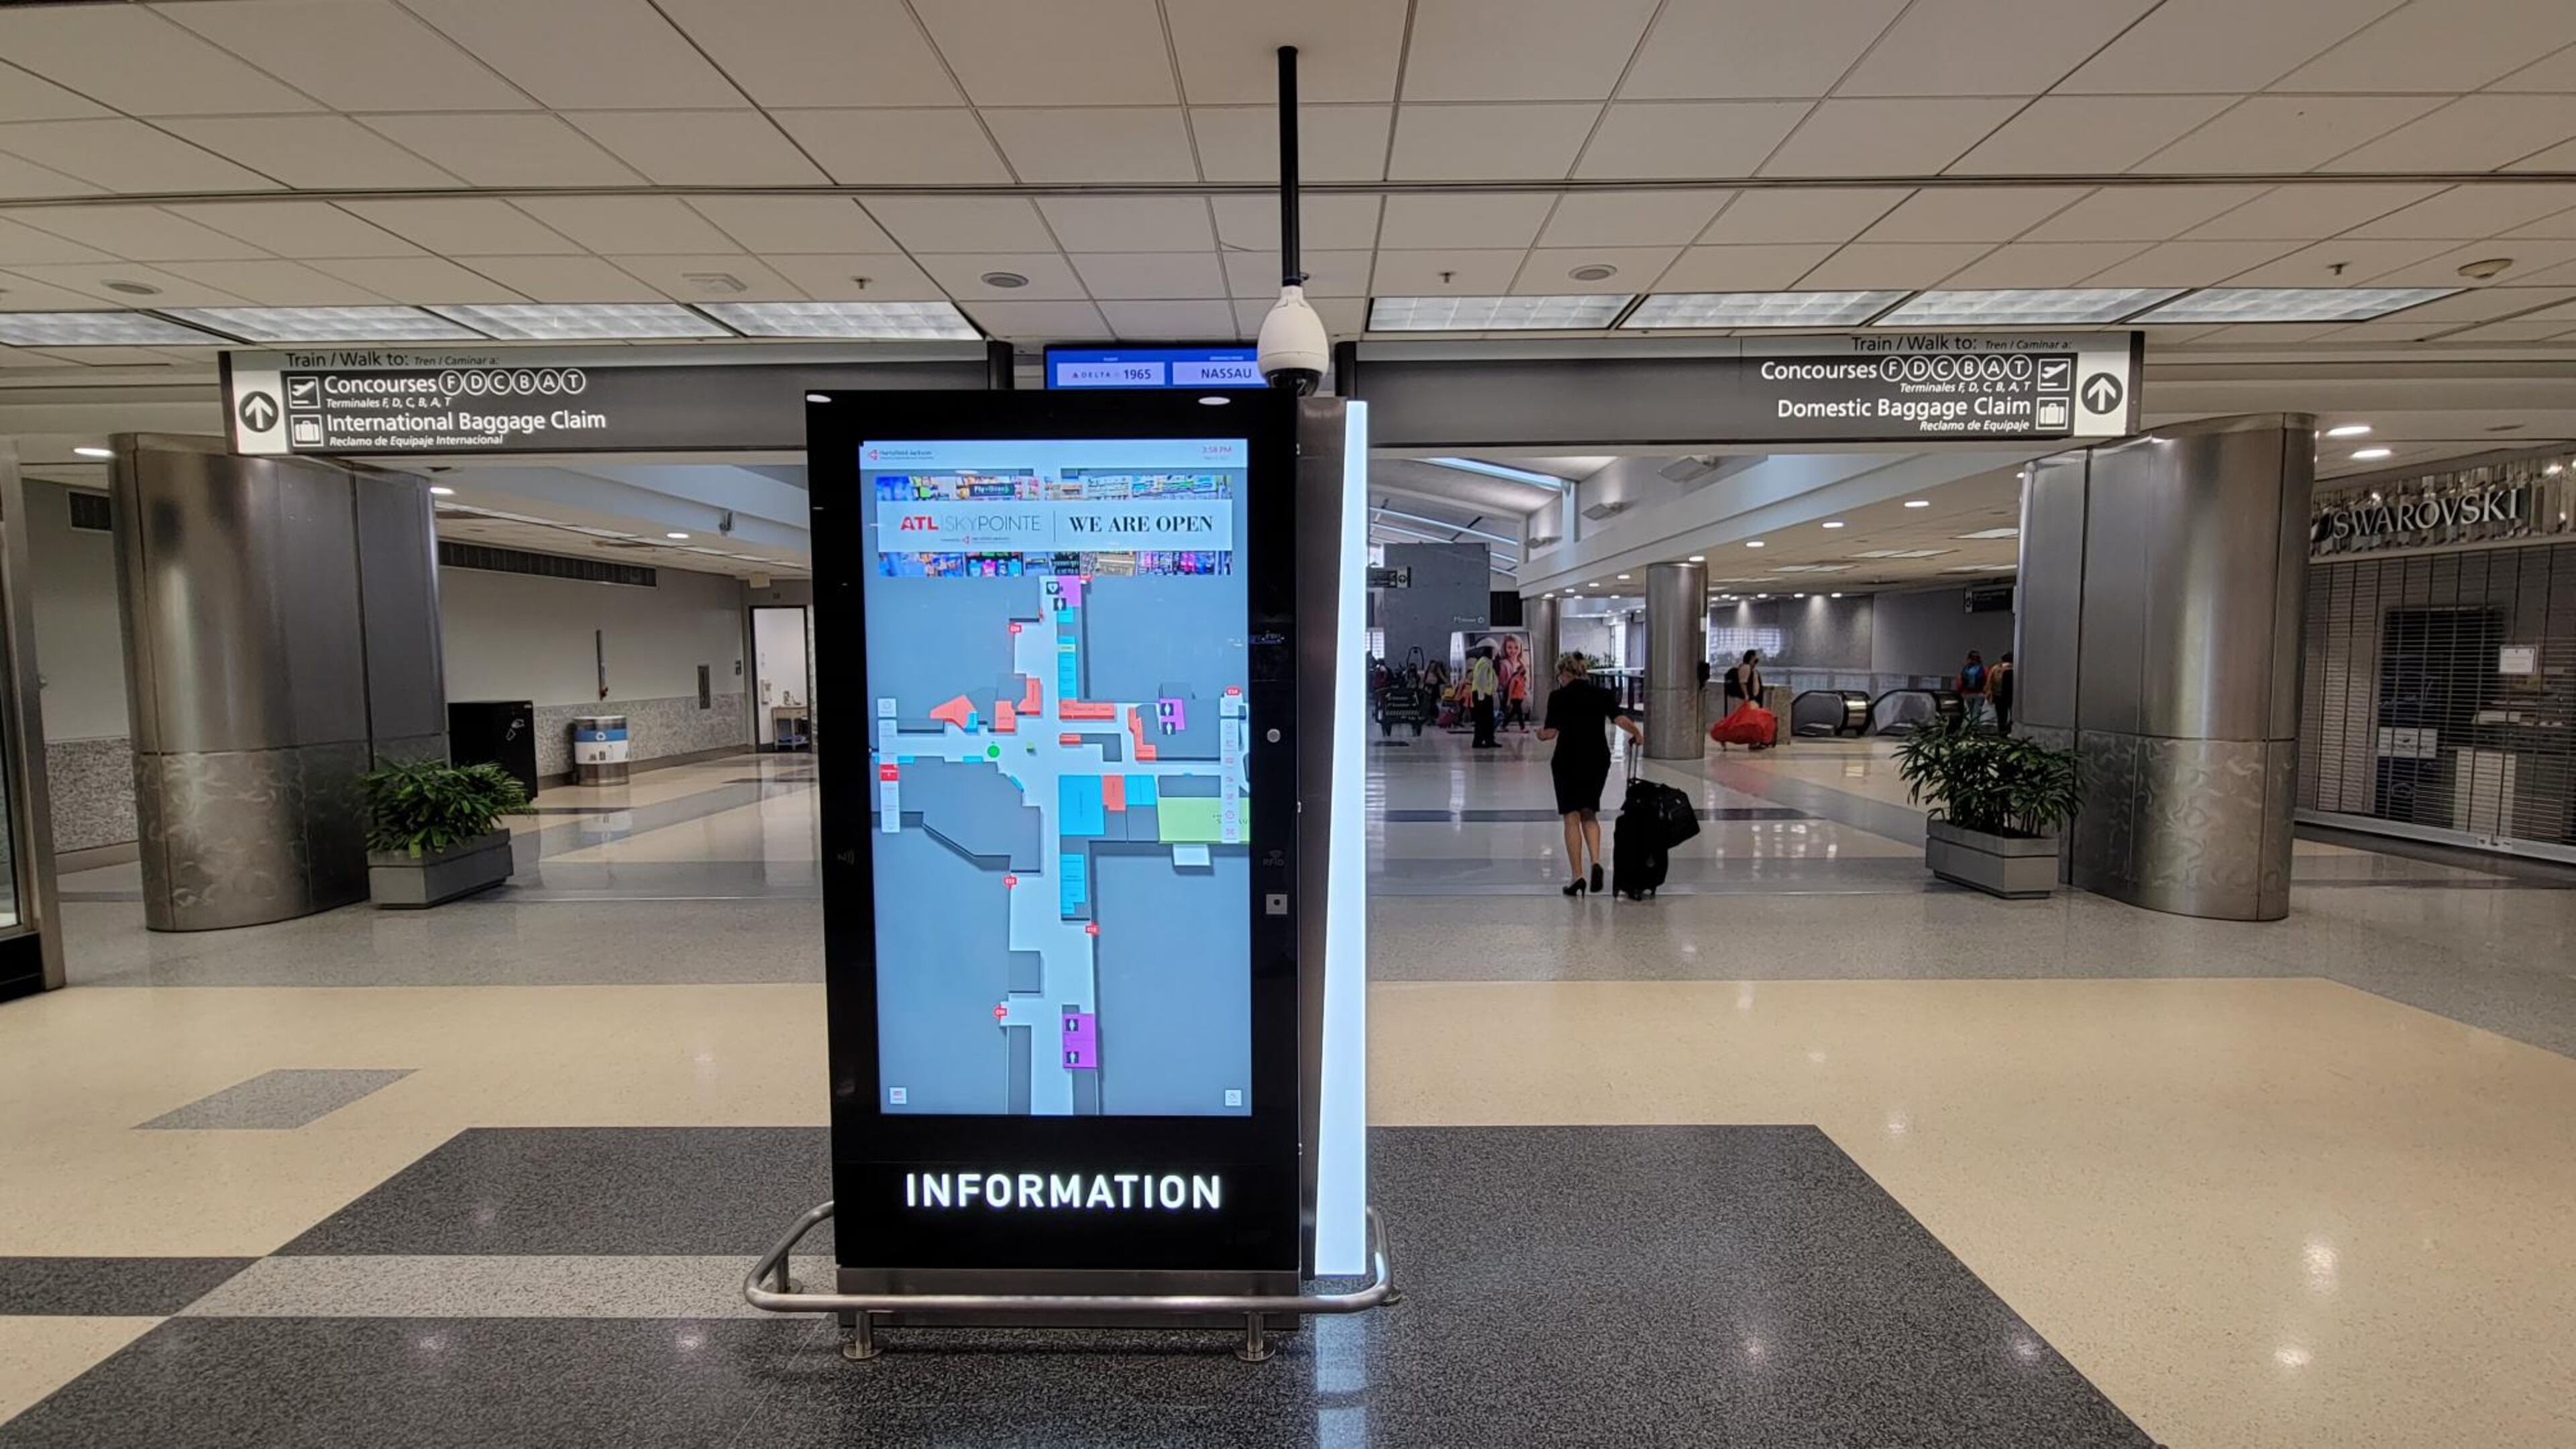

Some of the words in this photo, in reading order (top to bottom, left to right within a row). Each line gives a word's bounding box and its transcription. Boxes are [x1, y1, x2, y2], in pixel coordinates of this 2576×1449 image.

[1851, 337, 1892, 351] Train
[1907, 335, 1949, 350] Walk
[1955, 337, 1977, 350] to:
[1986, 341, 2007, 350] Tren
[2017, 339, 2059, 350] Caminar
[2061, 341, 2072, 349] a:
[286, 353, 326, 367] Train
[339, 352, 382, 366] Walk
[387, 353, 409, 366] to:
[415, 357, 435, 366] Tren
[444, 356, 486, 366] Caminar
[1124, 370, 1151, 379] 1965
[1201, 369, 1252, 378] NASSAU
[1761, 362, 1878, 380] Concourses
[324, 376, 437, 394] Concourses
[1900, 382, 1955, 393] Terminales
[2024, 381, 2031, 390] T
[326, 398, 379, 409] Terminales
[444, 397, 452, 407] T
[1778, 398, 1871, 417] Domestic
[1878, 398, 1968, 420] Baggage
[1974, 396, 2031, 415] Claim
[327, 412, 453, 431] International
[459, 412, 546, 434] Baggage
[551, 410, 606, 429] Claim
[1920, 421, 1964, 431] Reclamo
[1968, 420, 1980, 431] de
[1984, 419, 2030, 431] Equipaje
[329, 436, 371, 447] Reclamo
[376, 436, 388, 446] de
[390, 435, 433, 448] Equipaje
[436, 435, 503, 445] Internacional
[2333, 488, 2519, 539] SWAROVSKI
[900, 516, 938, 531] ATL
[945, 515, 1041, 531] SKYPOINTE
[1069, 516, 1102, 532] WE
[1108, 516, 1150, 532] ARE
[1156, 516, 1214, 532] OPEN
[906, 1173, 1220, 1209] INFORMATION
